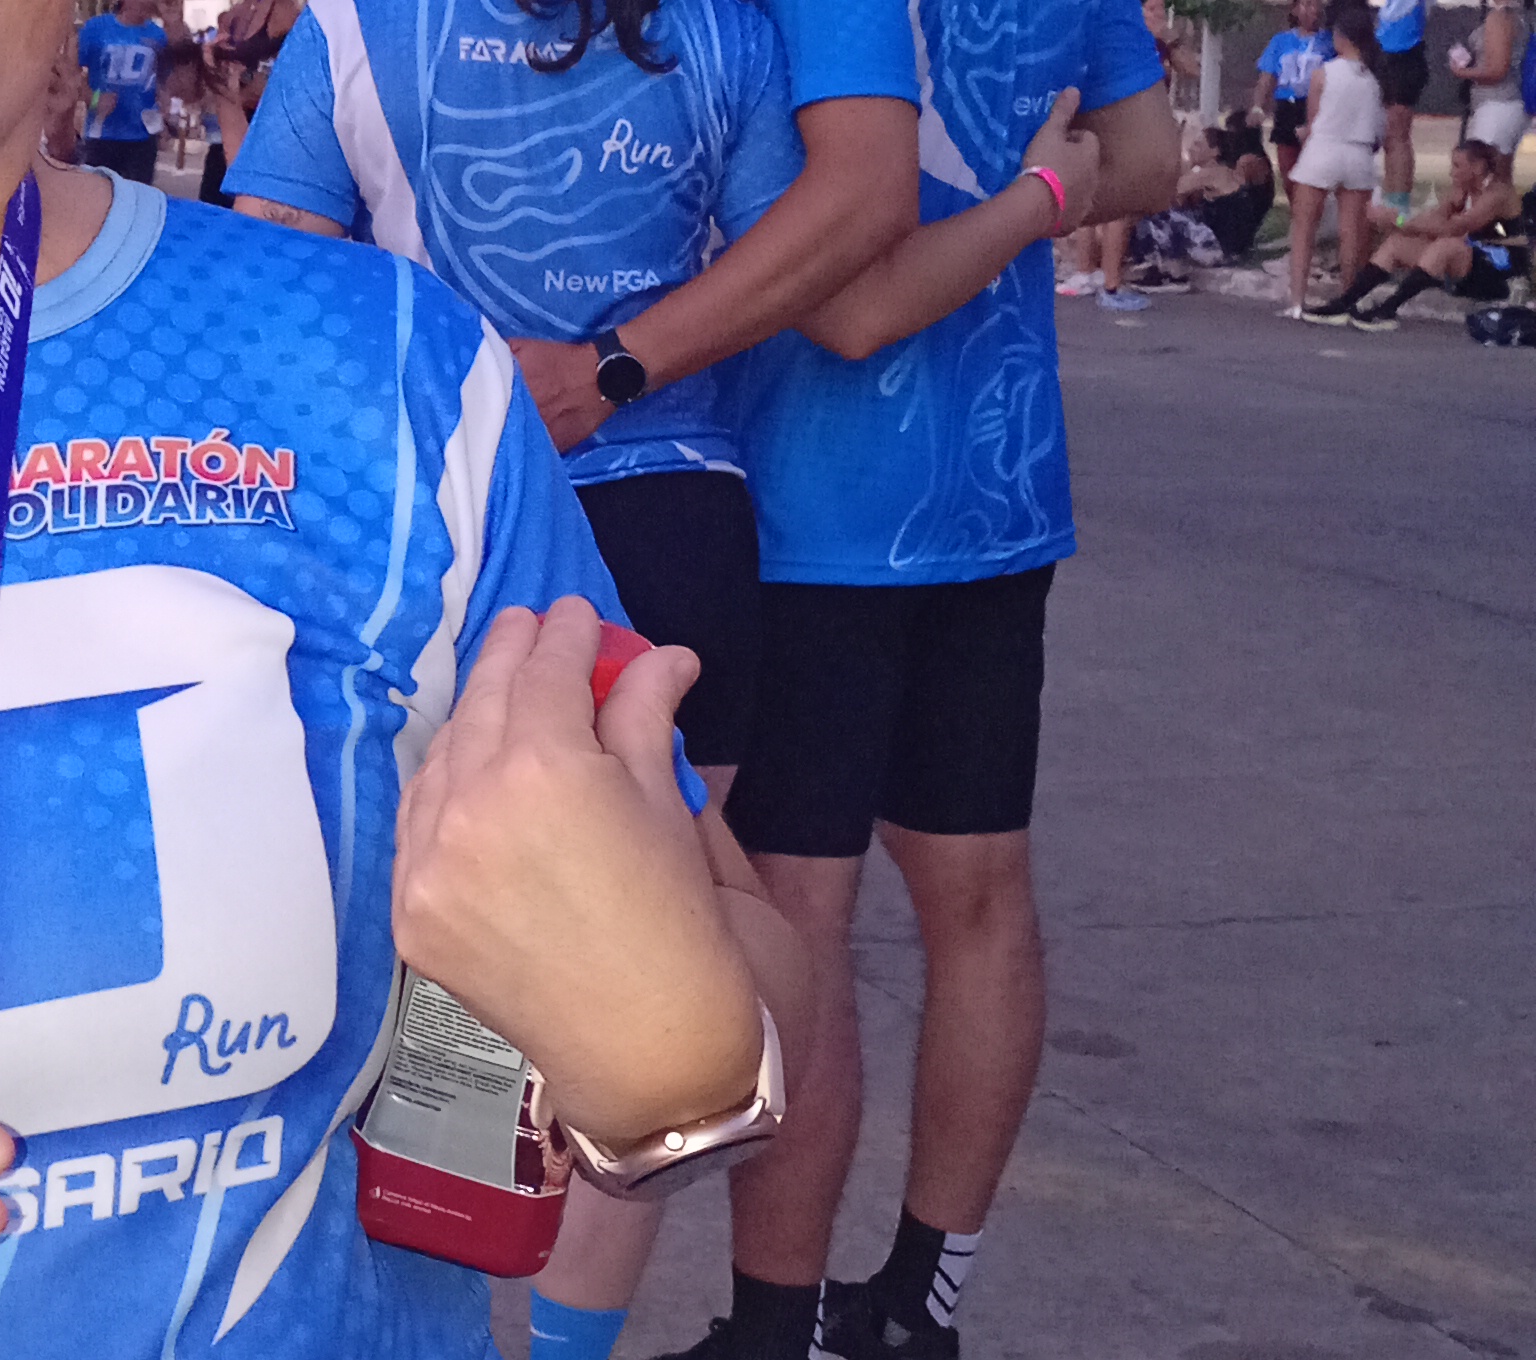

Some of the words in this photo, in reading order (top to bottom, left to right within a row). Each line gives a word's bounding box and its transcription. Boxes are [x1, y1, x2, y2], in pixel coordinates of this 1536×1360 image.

[598, 118, 675, 175] Run
[10, 428, 295, 491] ARATÓN
[160, 993, 298, 1085] Run
